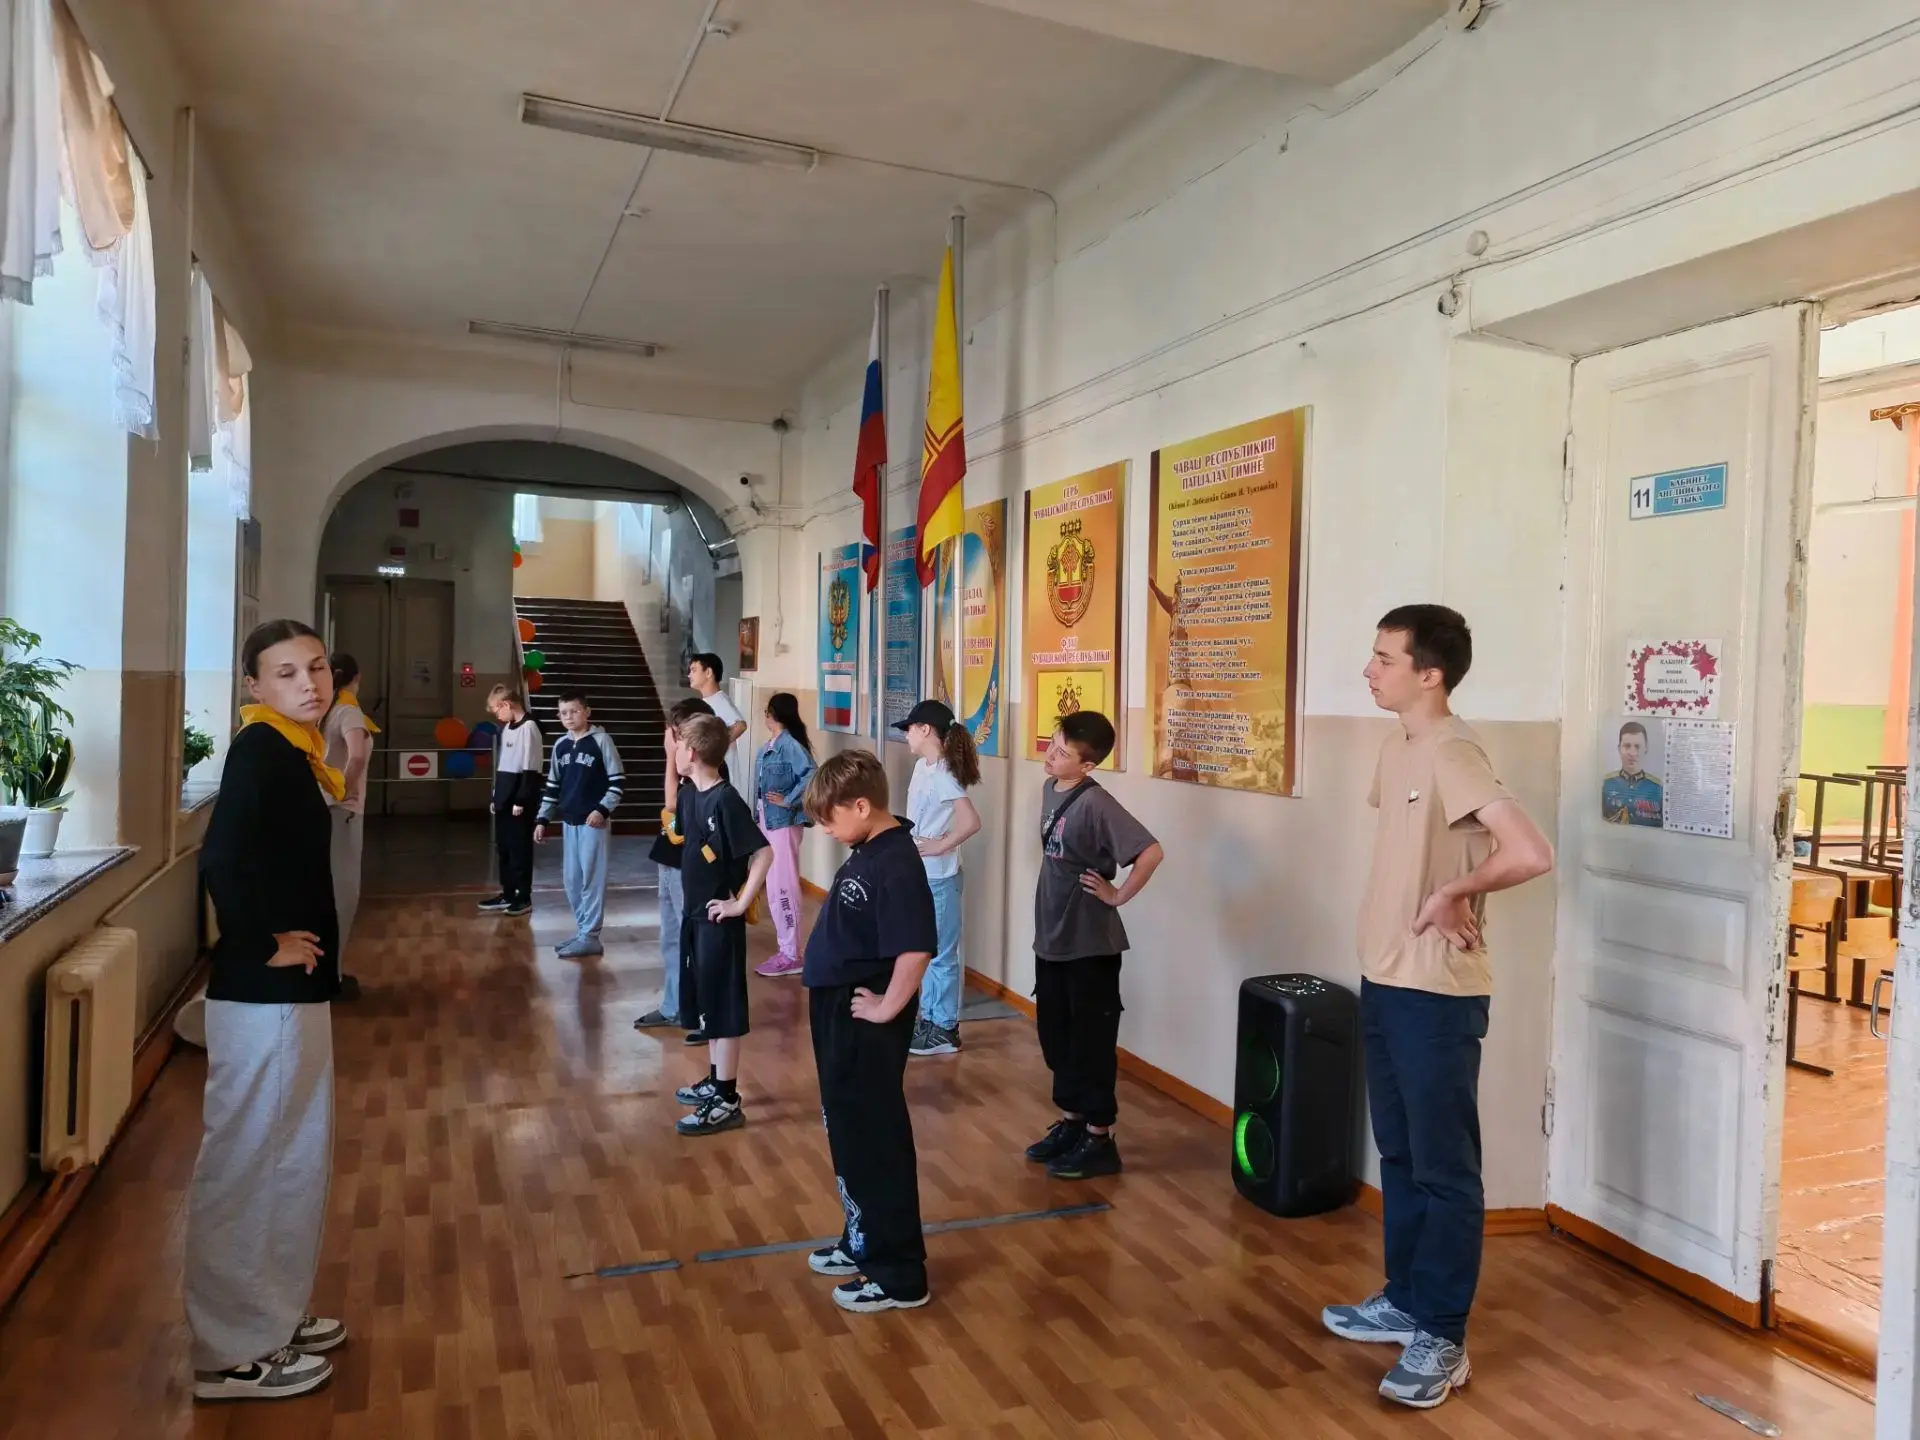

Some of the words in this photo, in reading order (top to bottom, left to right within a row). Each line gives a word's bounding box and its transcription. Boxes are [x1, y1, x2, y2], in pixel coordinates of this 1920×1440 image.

[1205, 437, 1275, 468] РЕСПУБЛИКИН
[1670, 475, 1709, 487] КАБИНЕТ
[1634, 488, 1650, 508] 11
[1659, 483, 1720, 498] АНГЛИЙСКОГО
[1673, 495, 1704, 505] ЯЗЫКА
